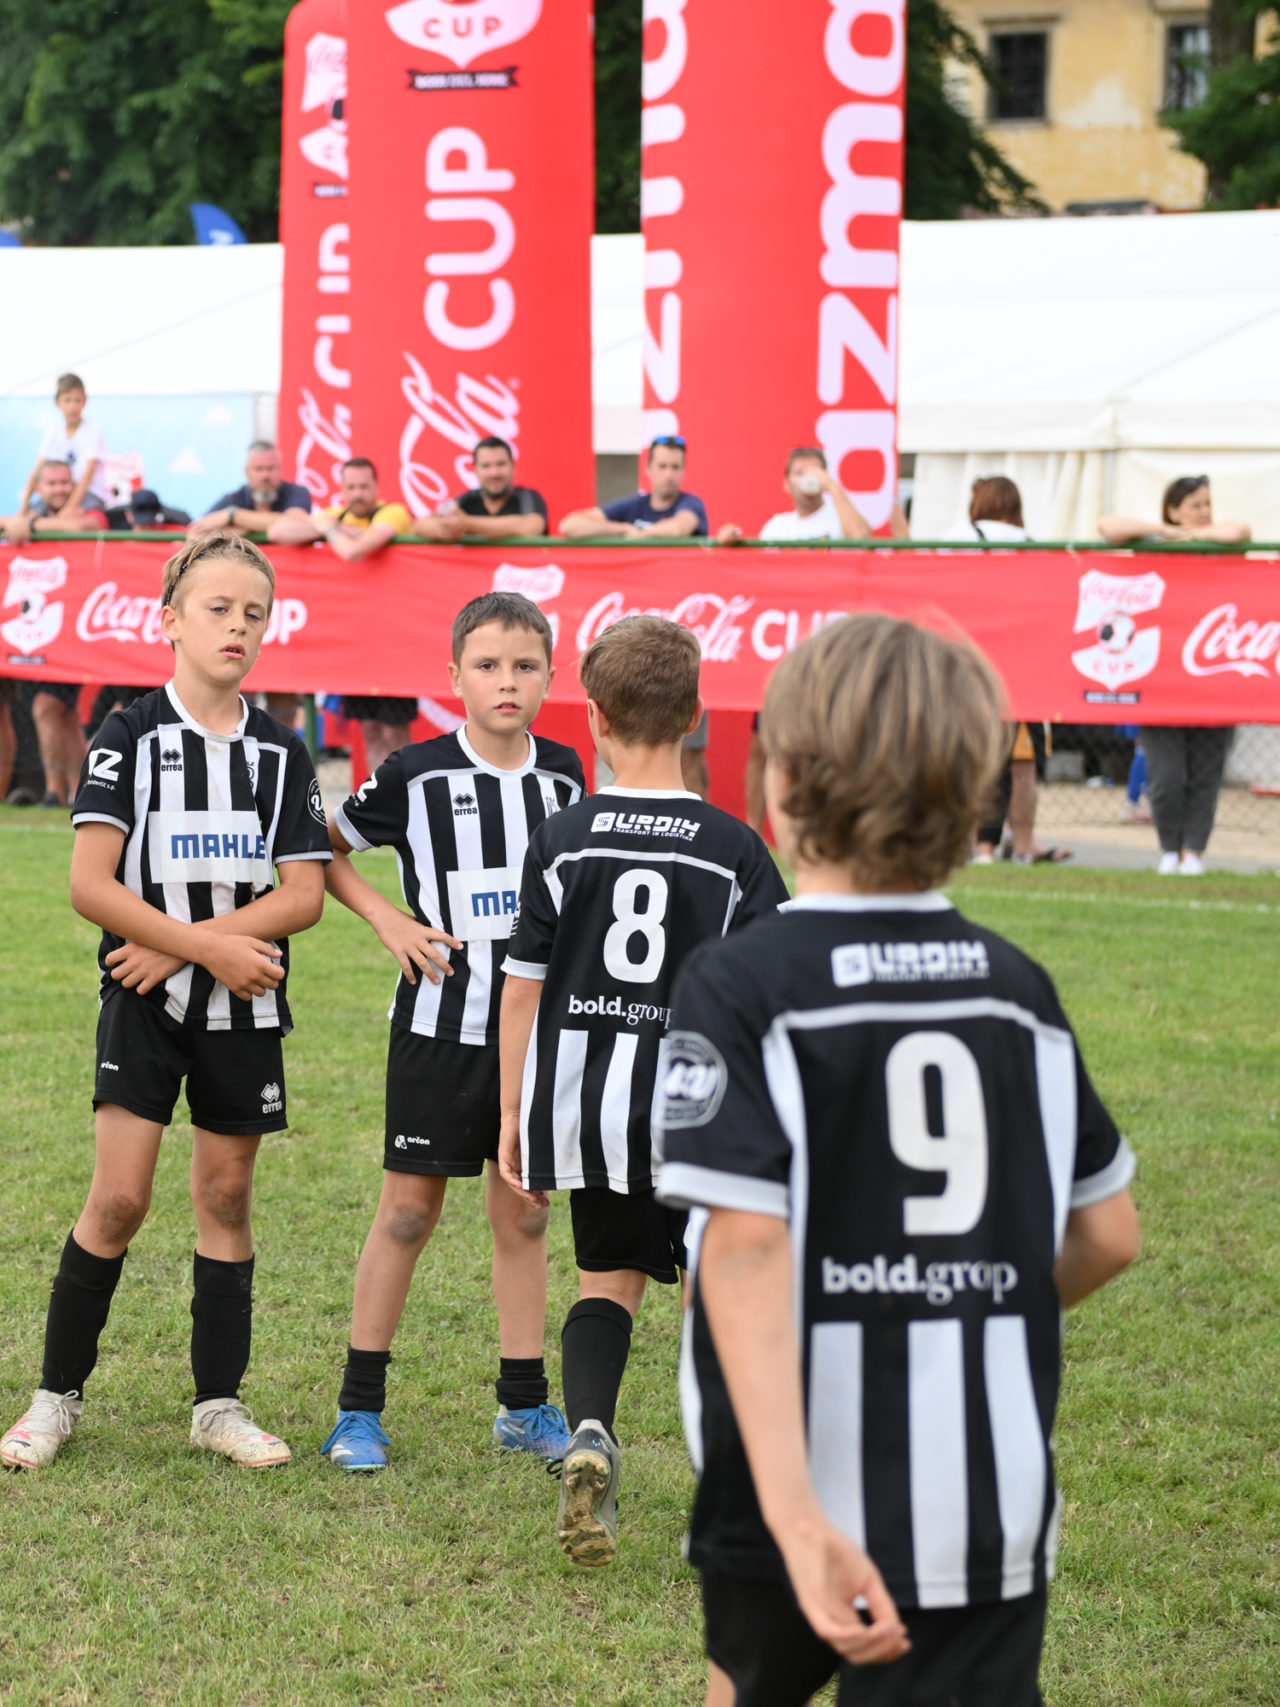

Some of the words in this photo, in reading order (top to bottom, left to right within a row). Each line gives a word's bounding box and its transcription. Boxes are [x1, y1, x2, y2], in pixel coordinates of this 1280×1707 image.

[423, 16, 503, 39] CUP
[423, 126, 517, 351] CUP
[1093, 659, 1135, 674] CUP
[161, 763, 183, 772] errea
[454, 807, 478, 816] errea
[171, 834, 266, 860] MAHLE
[603, 868, 669, 984] 8
[262, 1101, 283, 1114] errea
[406, 1136, 430, 1145] arčon
[885, 1030, 989, 1236] 9
